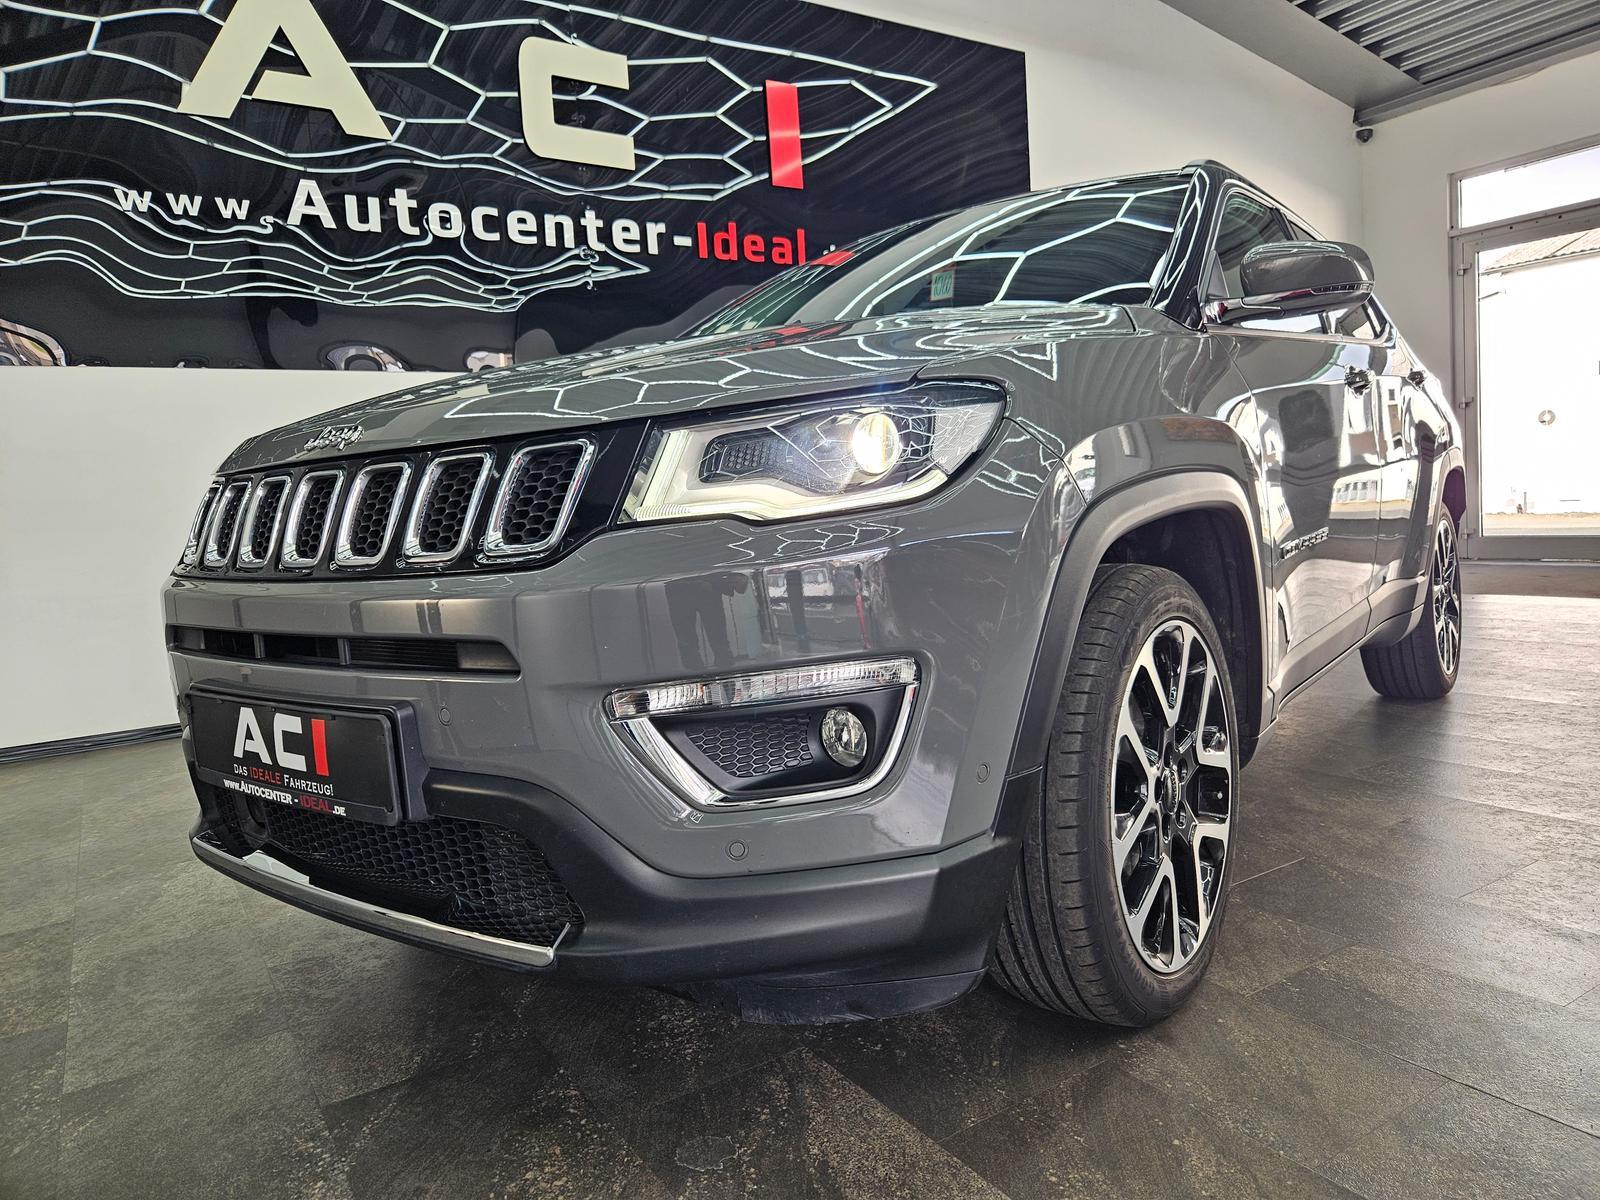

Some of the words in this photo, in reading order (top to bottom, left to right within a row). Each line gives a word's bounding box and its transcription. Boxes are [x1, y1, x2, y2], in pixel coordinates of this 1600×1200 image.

[113, 179, 836, 266] www.Autocenter-Ideal
[233, 706, 330, 777] ACI
[233, 764, 248, 776] DAS
[249, 767, 282, 785] IDEALE
[283, 774, 334, 796] FAHRZEUG!
